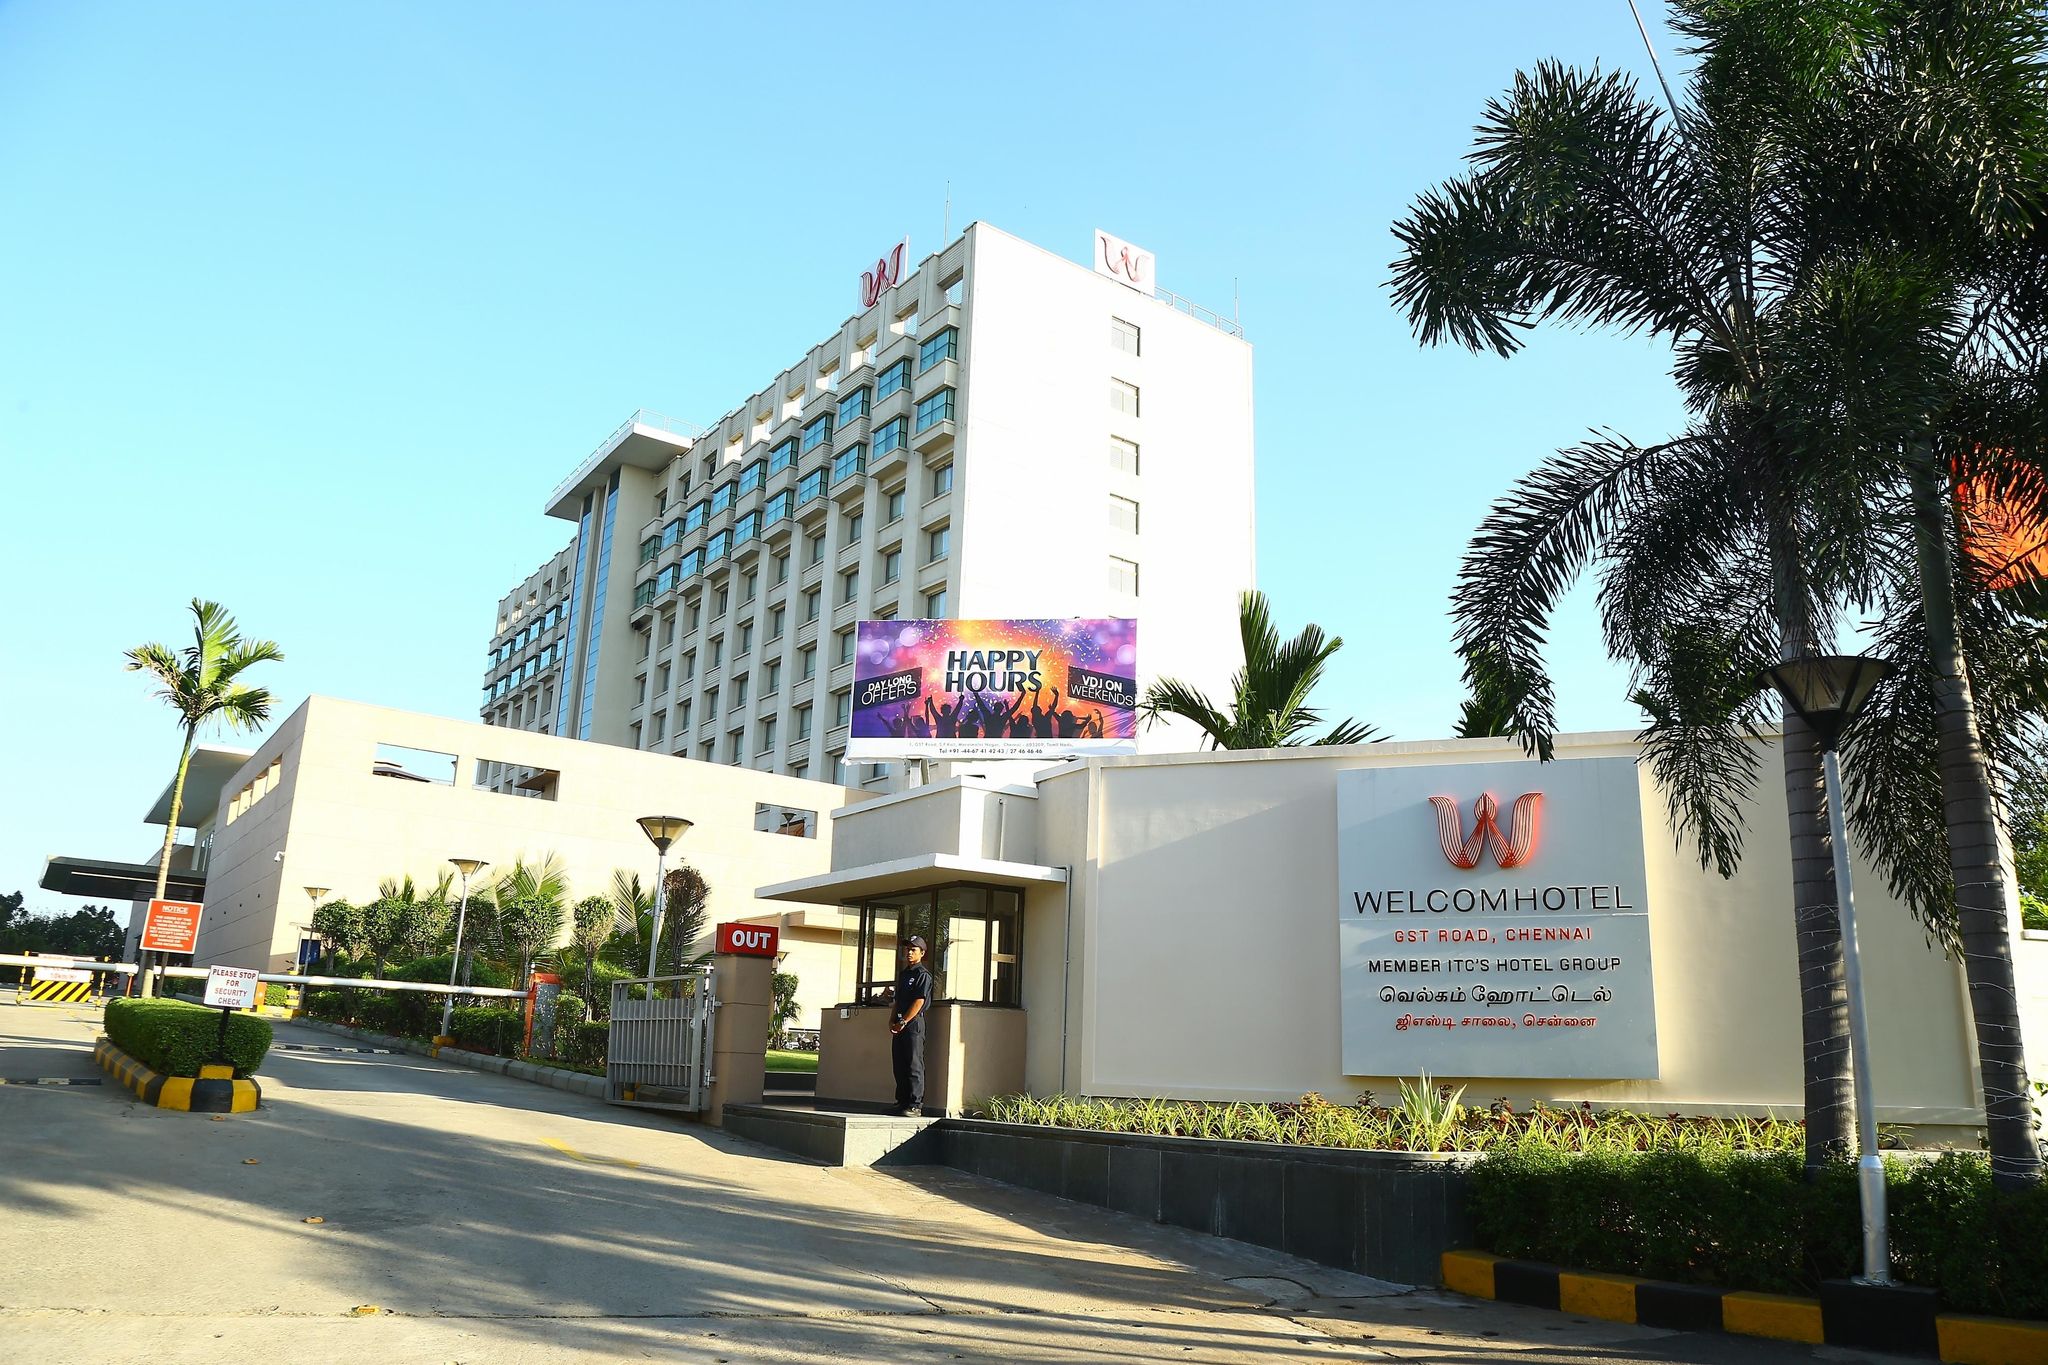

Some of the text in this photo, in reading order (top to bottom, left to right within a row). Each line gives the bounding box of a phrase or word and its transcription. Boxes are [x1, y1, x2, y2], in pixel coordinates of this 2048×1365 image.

[946, 650, 1043, 671] HAPPY
[945, 671, 1043, 693] HOURS
[1082, 675, 1122, 692] VDJ ON
[861, 681, 917, 705] OFFERS
[1070, 683, 1134, 706] WEEKENDS
[1353, 885, 1633, 914] WELCOMHOTEL
[162, 905, 189, 914] NOTICE
[732, 929, 771, 949] OUT
[1394, 927, 1592, 944] GST ROAD, CHENNAI
[1368, 957, 1621, 973] MEMBER ITC'S HOTEL GROUP
[212, 969, 257, 980] PLEASE STOP
[225, 979, 240, 987] FOR
[214, 987, 248, 997] SECURITY
[1379, 985, 1467, 1003] வெல்கம்
[217, 997, 241, 1005] CHECK
[1395, 1013, 1597, 1031] ஜிஎஸ்டி சாலை, சென்னை
